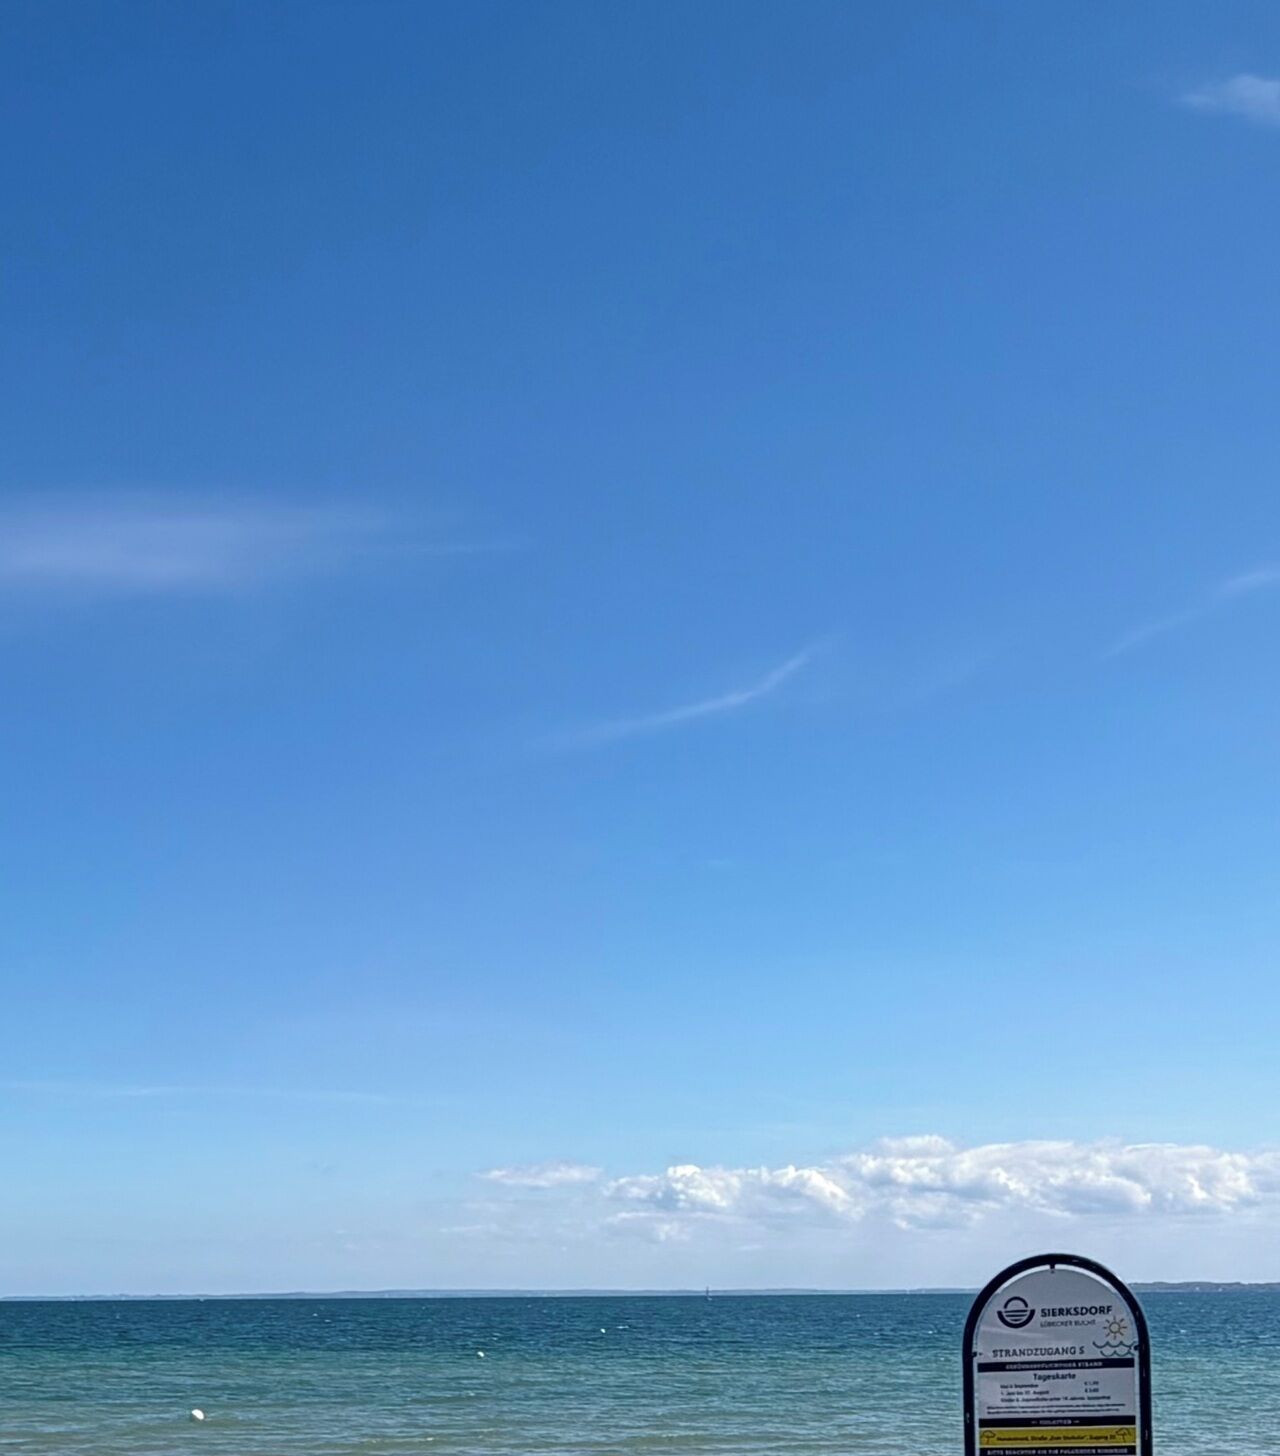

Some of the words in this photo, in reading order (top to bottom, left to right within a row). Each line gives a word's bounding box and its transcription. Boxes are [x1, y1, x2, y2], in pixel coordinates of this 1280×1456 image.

[1040, 1305, 1113, 1318] SIERKSDORF
[992, 1346, 1076, 1358] STRANDZUGANG
[1033, 1373, 1076, 1382] Tageskarte
